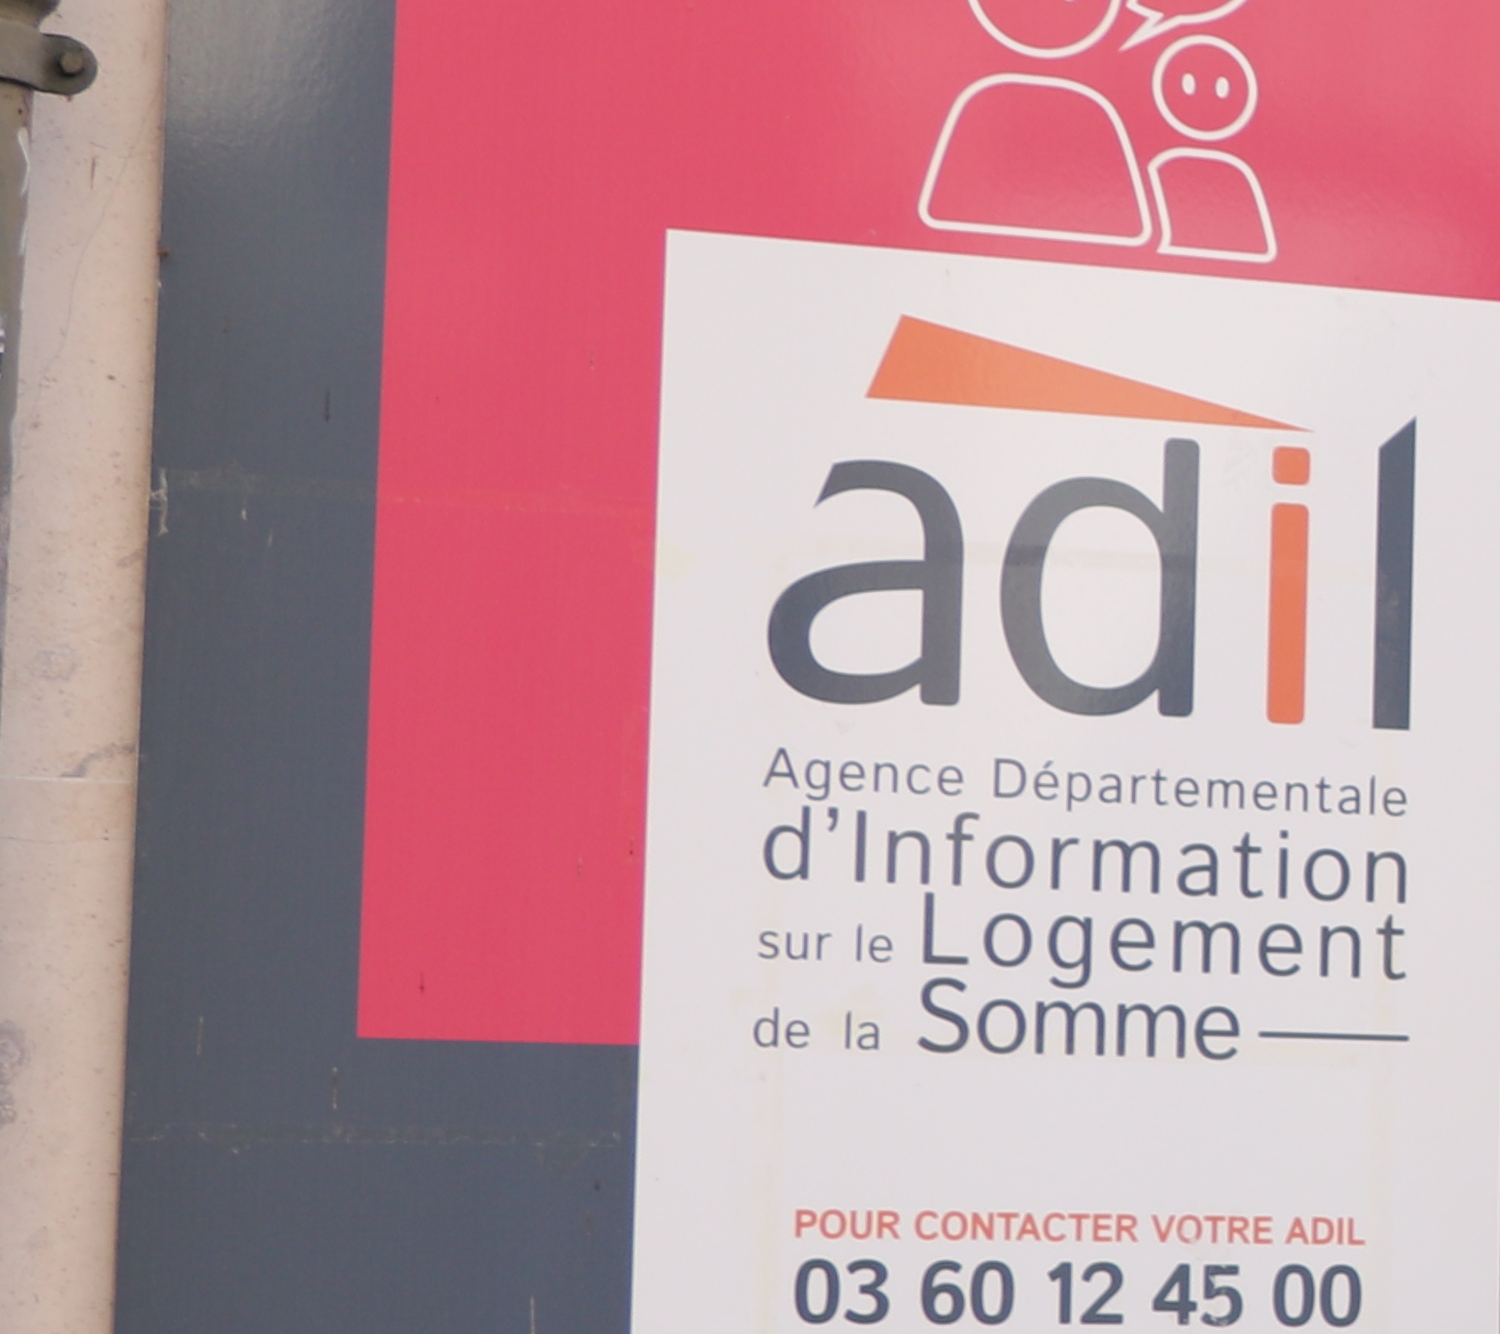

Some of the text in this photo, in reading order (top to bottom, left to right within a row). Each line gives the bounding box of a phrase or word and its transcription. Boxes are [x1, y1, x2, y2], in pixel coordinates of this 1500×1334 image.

[766, 417, 1418, 732] adil
[762, 746, 1408, 818] Agence Départementale
[758, 891, 1408, 991] sur le Logement
[752, 976, 1241, 1062] de la Somme
[794, 1208, 1366, 1247] POUR CONTACTER VOTRE ADIL
[793, 1257, 1363, 1329] 03 60 12 45 00
